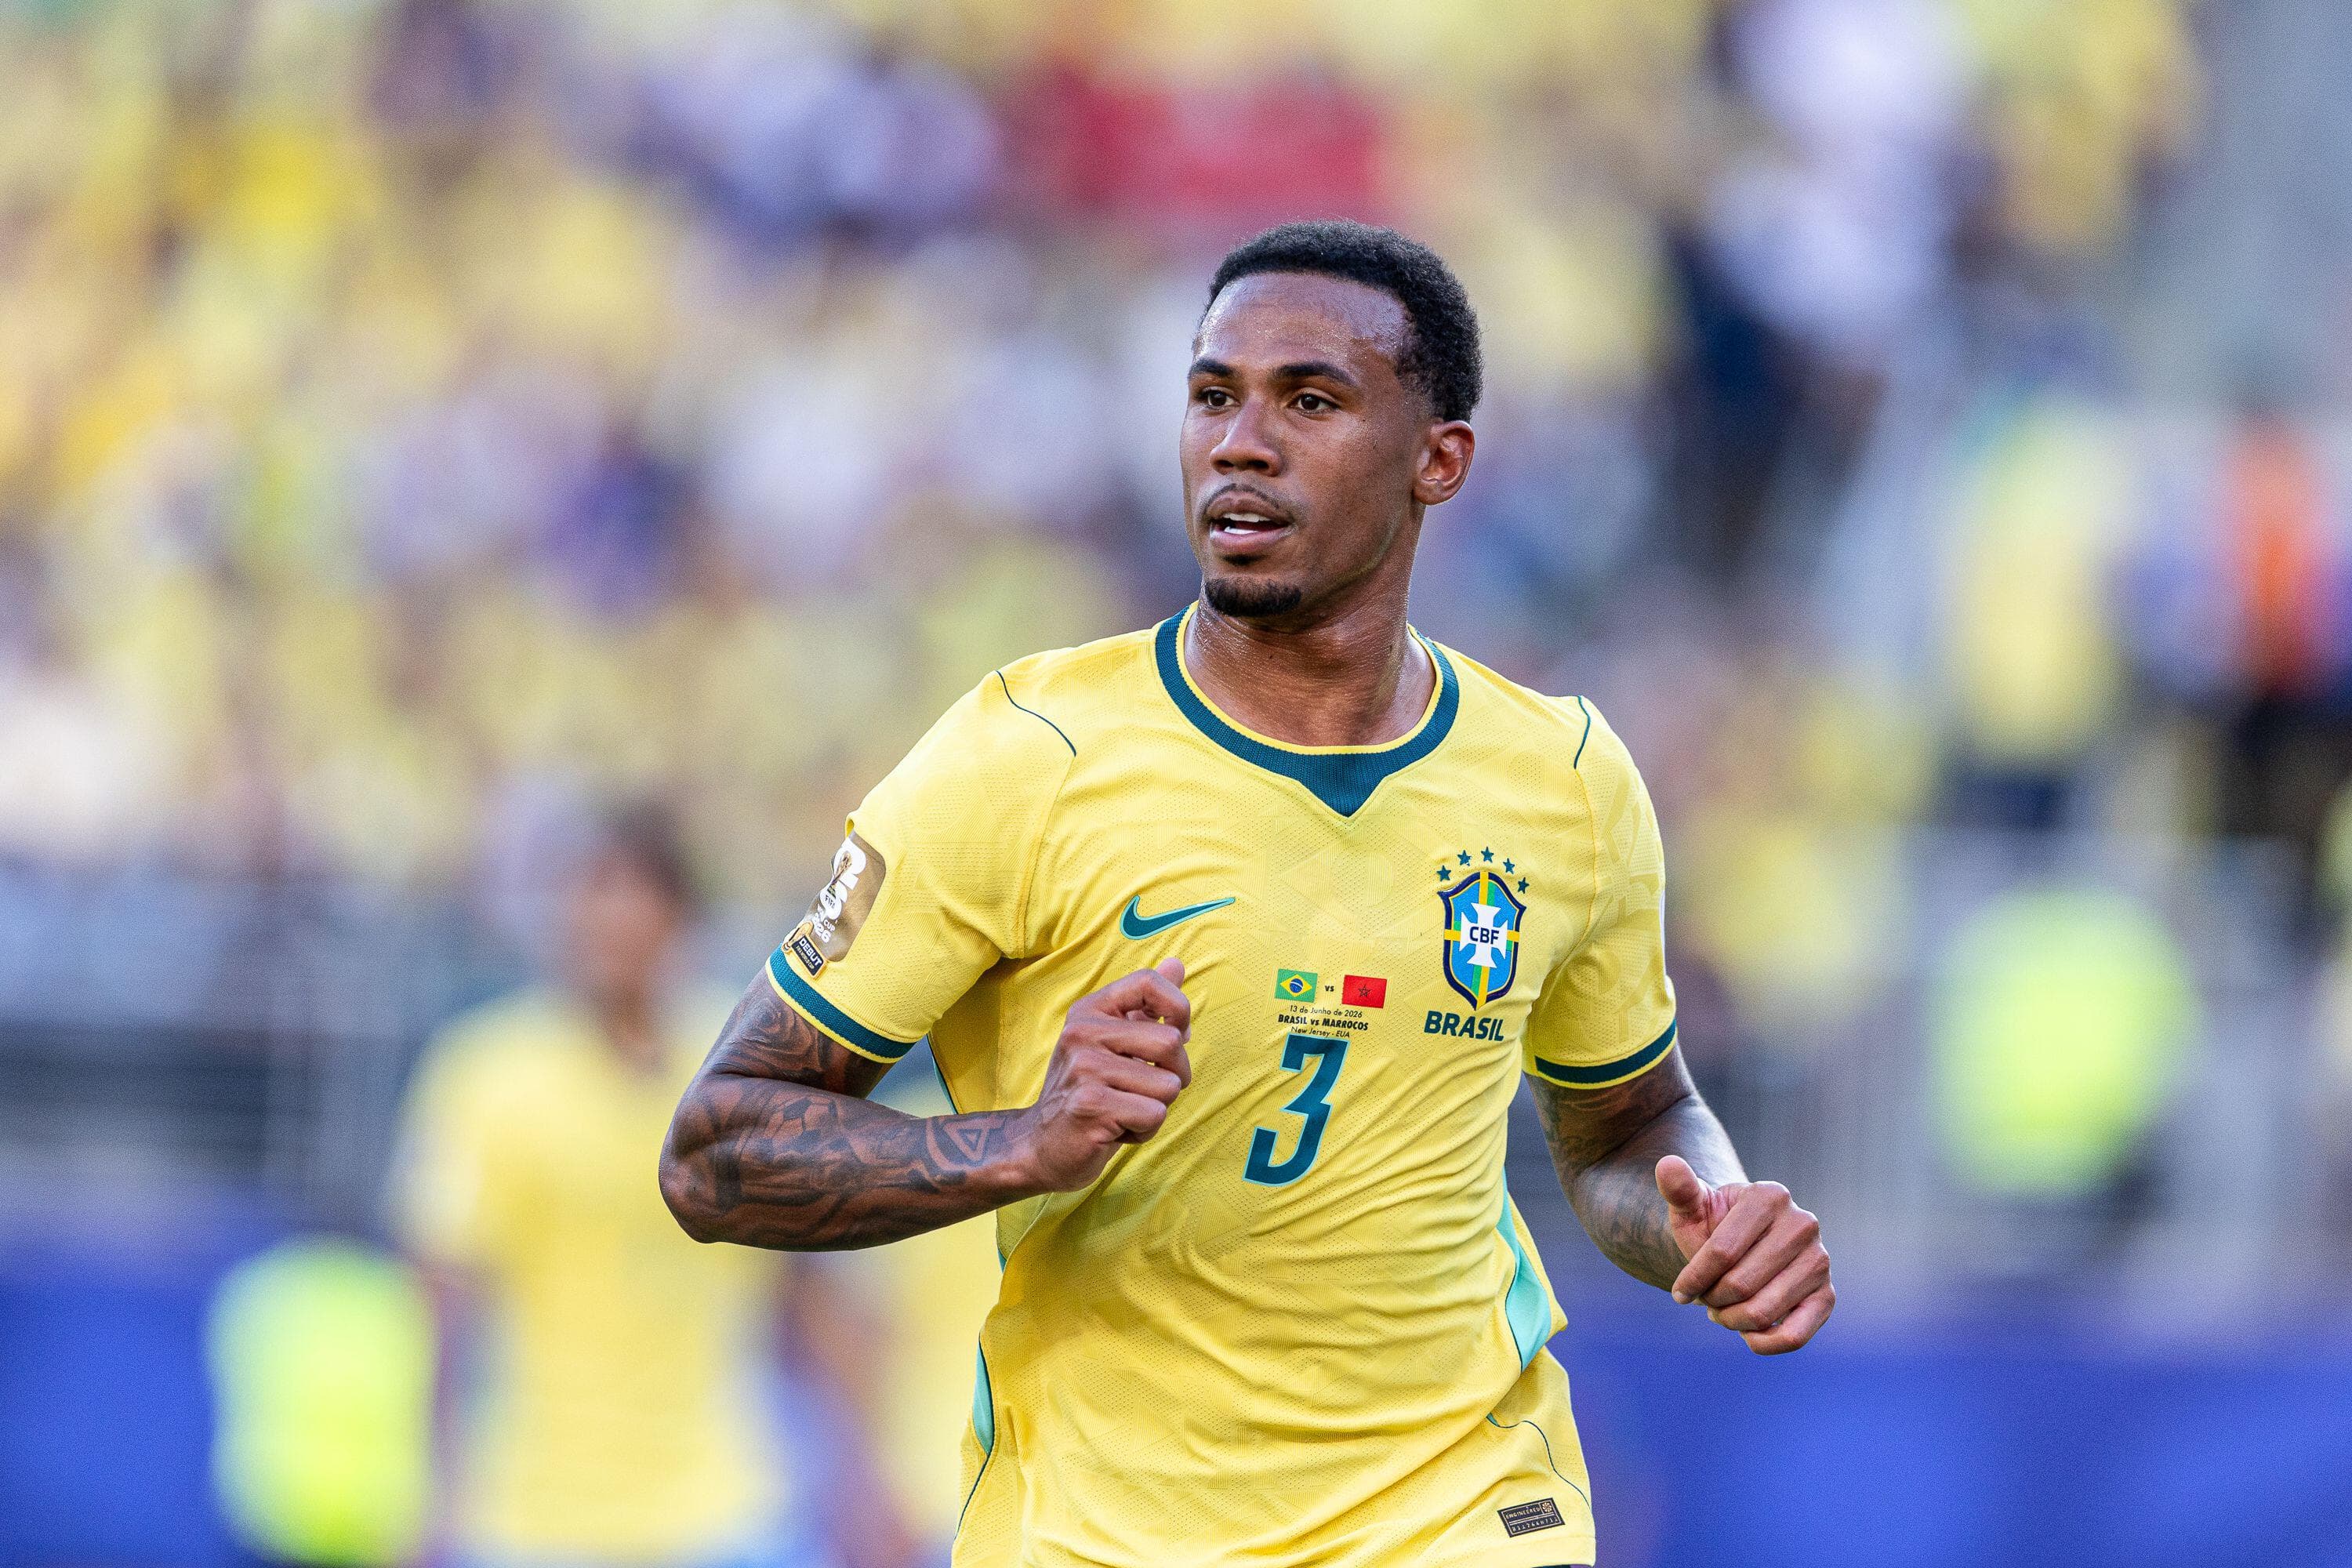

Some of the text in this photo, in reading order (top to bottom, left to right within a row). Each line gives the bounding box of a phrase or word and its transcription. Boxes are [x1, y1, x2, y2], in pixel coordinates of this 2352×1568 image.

[823, 919, 836, 931] CUP
[1469, 926, 1500, 945] CBF
[799, 938, 822, 966] DEBUT
[1345, 1009, 1363, 1018] 2026
[1278, 1014, 1308, 1025] BRASIL
[1322, 1018, 1369, 1031] MARROCOS
[1424, 1010, 1504, 1042] BRASIL
[1308, 1028, 1330, 1037] Jersey
[1242, 1032, 1351, 1187] 3
[1505, 1507, 1541, 1519] ENGINEERED
